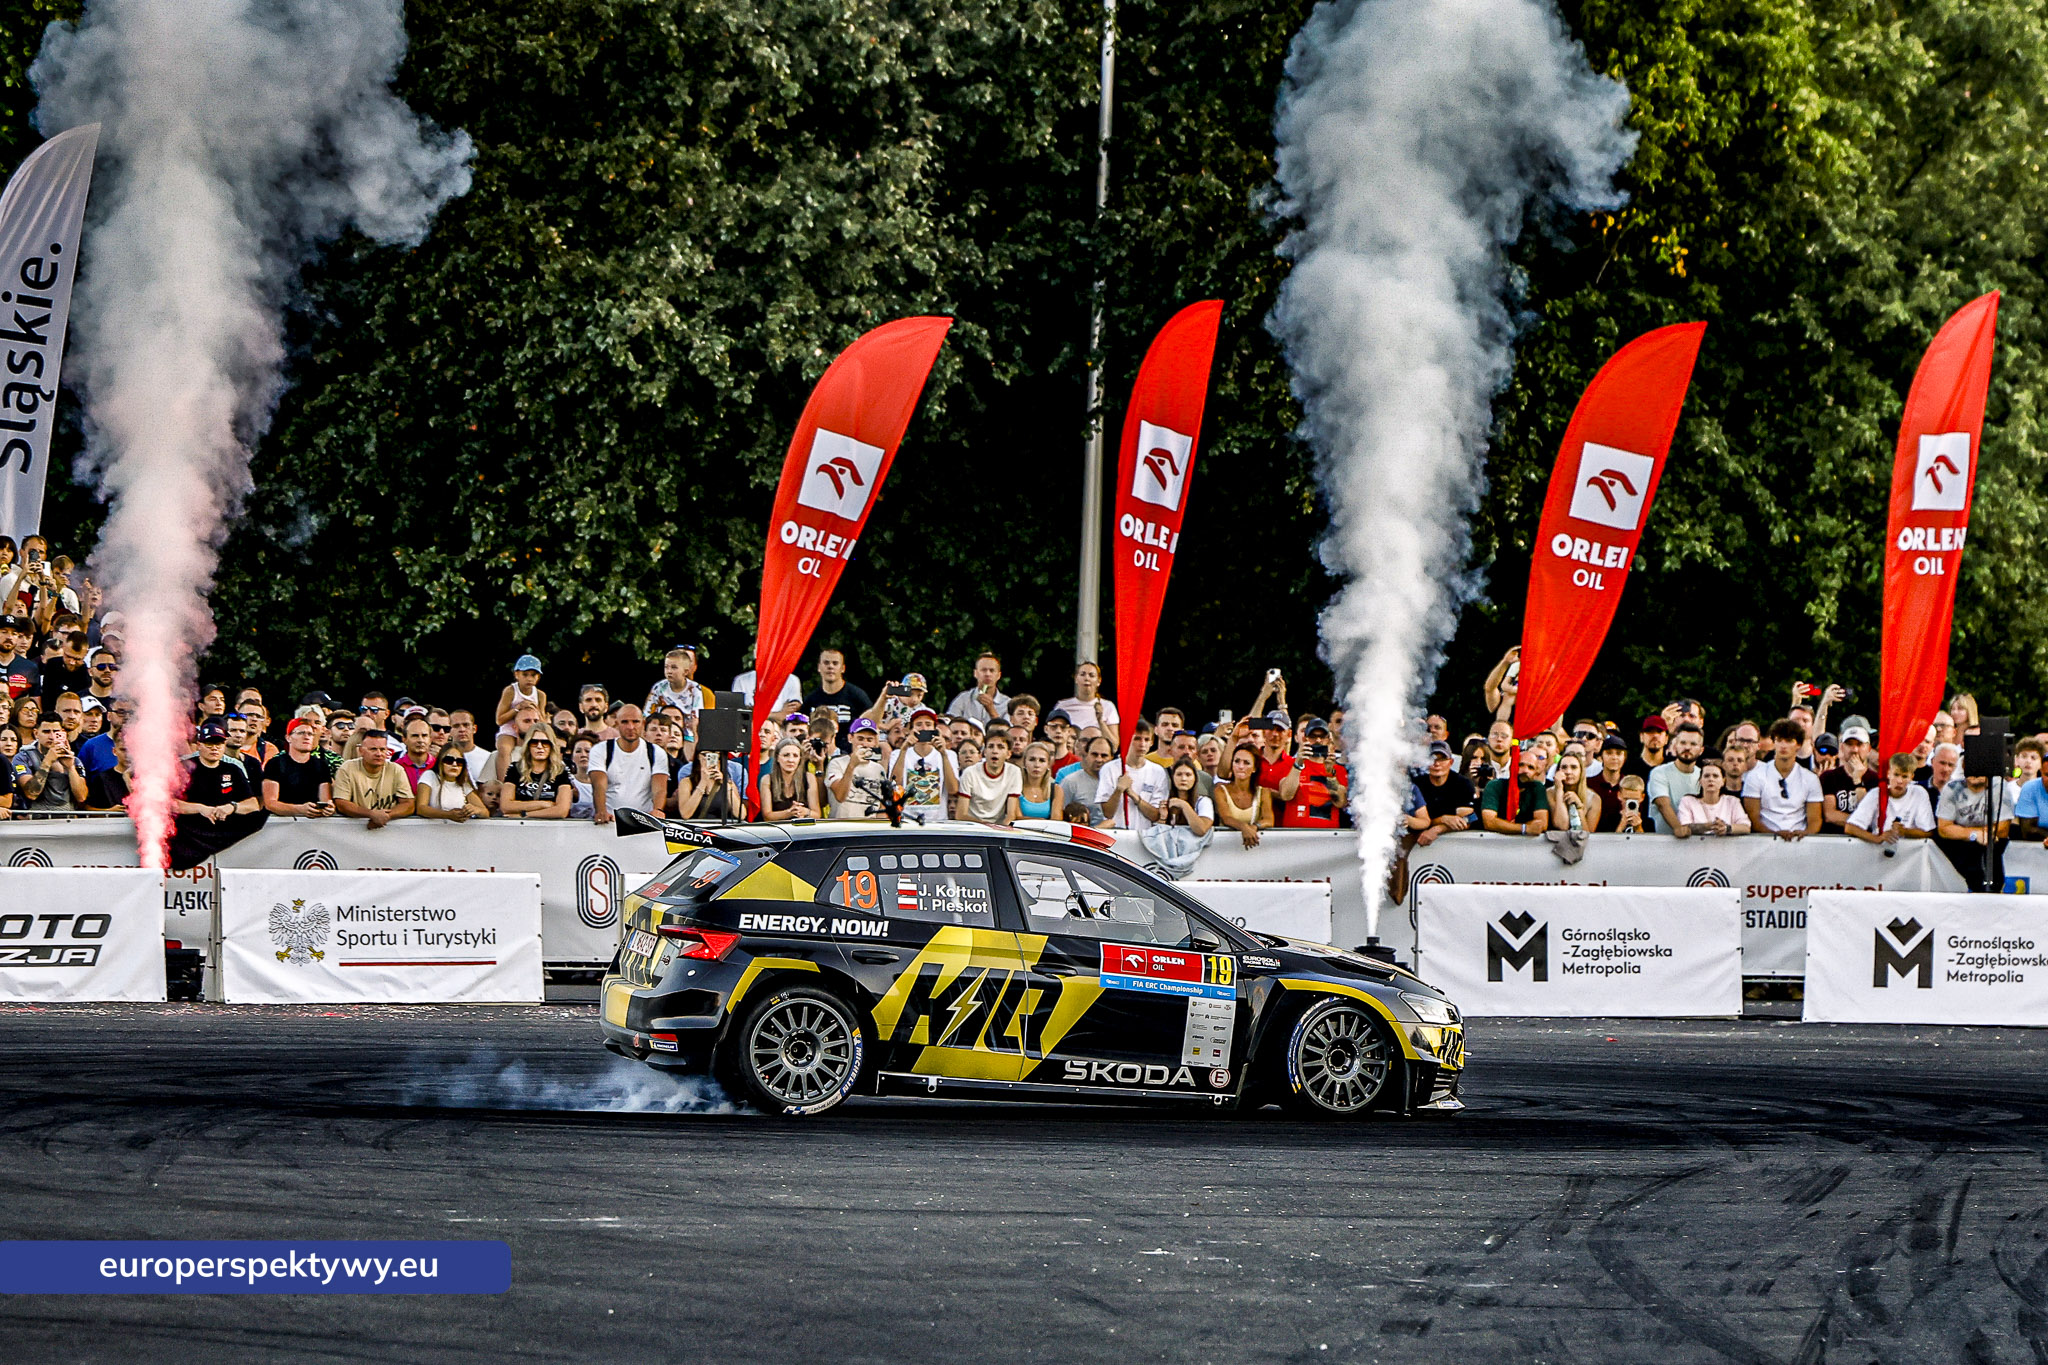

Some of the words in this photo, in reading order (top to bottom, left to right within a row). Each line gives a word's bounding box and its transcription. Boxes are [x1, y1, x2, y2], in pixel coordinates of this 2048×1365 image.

[1134, 549, 1160, 572] OIL
[1913, 556, 1945, 575] OIL
[1573, 568, 1605, 590] OIL
[836, 870, 878, 909] 19
[918, 884, 931, 897] J.
[936, 885, 986, 899] Kołtun
[336, 905, 456, 922] Ministerstwo
[932, 899, 988, 913] Pleskot
[738, 913, 826, 934] ENERGY.
[831, 918, 890, 937] NOW!
[336, 929, 397, 949] Sportu
[403, 928, 408, 945] i
[413, 927, 497, 949] Turystyki
[1561, 928, 1651, 944] Górnośląsko
[1947, 935, 2035, 952] Górnośląsko
[1152, 955, 1185, 966] ORLEN
[1152, 964, 1165, 972] OIL
[1208, 955, 1233, 985] 19
[1562, 962, 1641, 977] Metropolia
[1946, 970, 2024, 985] Metropolia
[1132, 980, 1144, 988] FIA
[1145, 981, 1158, 990] ERC
[1159, 982, 1203, 995] Championship
[842, 1046, 862, 1094] MICHELIN
